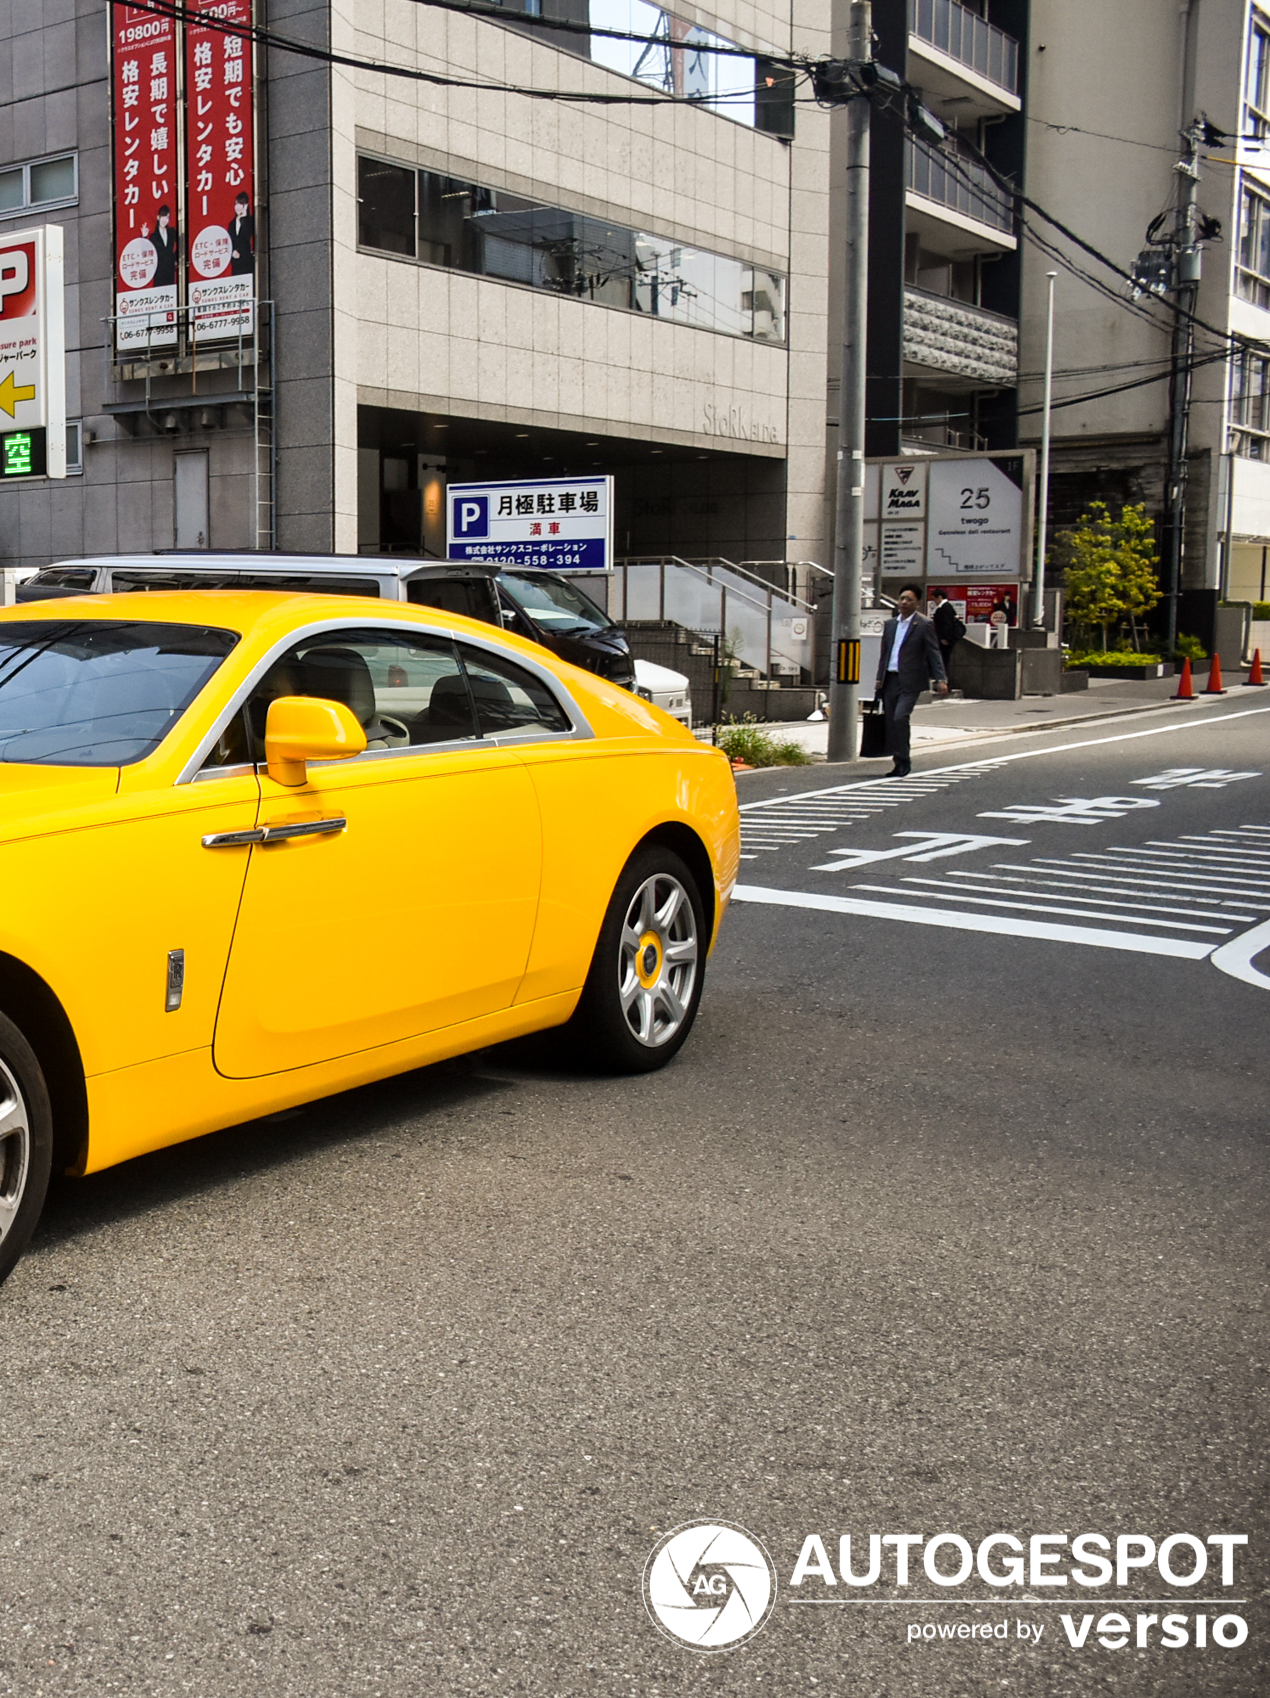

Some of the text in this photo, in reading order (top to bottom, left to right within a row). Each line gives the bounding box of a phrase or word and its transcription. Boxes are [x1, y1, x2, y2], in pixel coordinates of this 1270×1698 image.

[223, 35, 244, 186] 短期でも安心
[150, 51, 168, 199] 長期で嬉しい
[194, 41, 212, 216] 格安レンタカー
[121, 59, 139, 228] 格安レンタカー
[195, 248, 229, 259] ロードサービス
[122, 260, 154, 270] ロードサービス
[203, 258, 221, 270] 完備
[130, 269, 147, 280] 完備
[202, 283, 250, 297] サンクスレンタカー
[129, 294, 174, 307] サンクスレンタカー
[197, 316, 250, 331] 06-6777-9958
[19, 337, 37, 351] park
[4, 433, 32, 475] 空
[497, 491, 599, 516] 月極駐車場
[960, 487, 990, 509] 25
[961, 517, 989, 526] twogo
[465, 543, 588, 555] 株式会社サンクスコーポレーション
[486, 554, 581, 565] 0120-558-394
